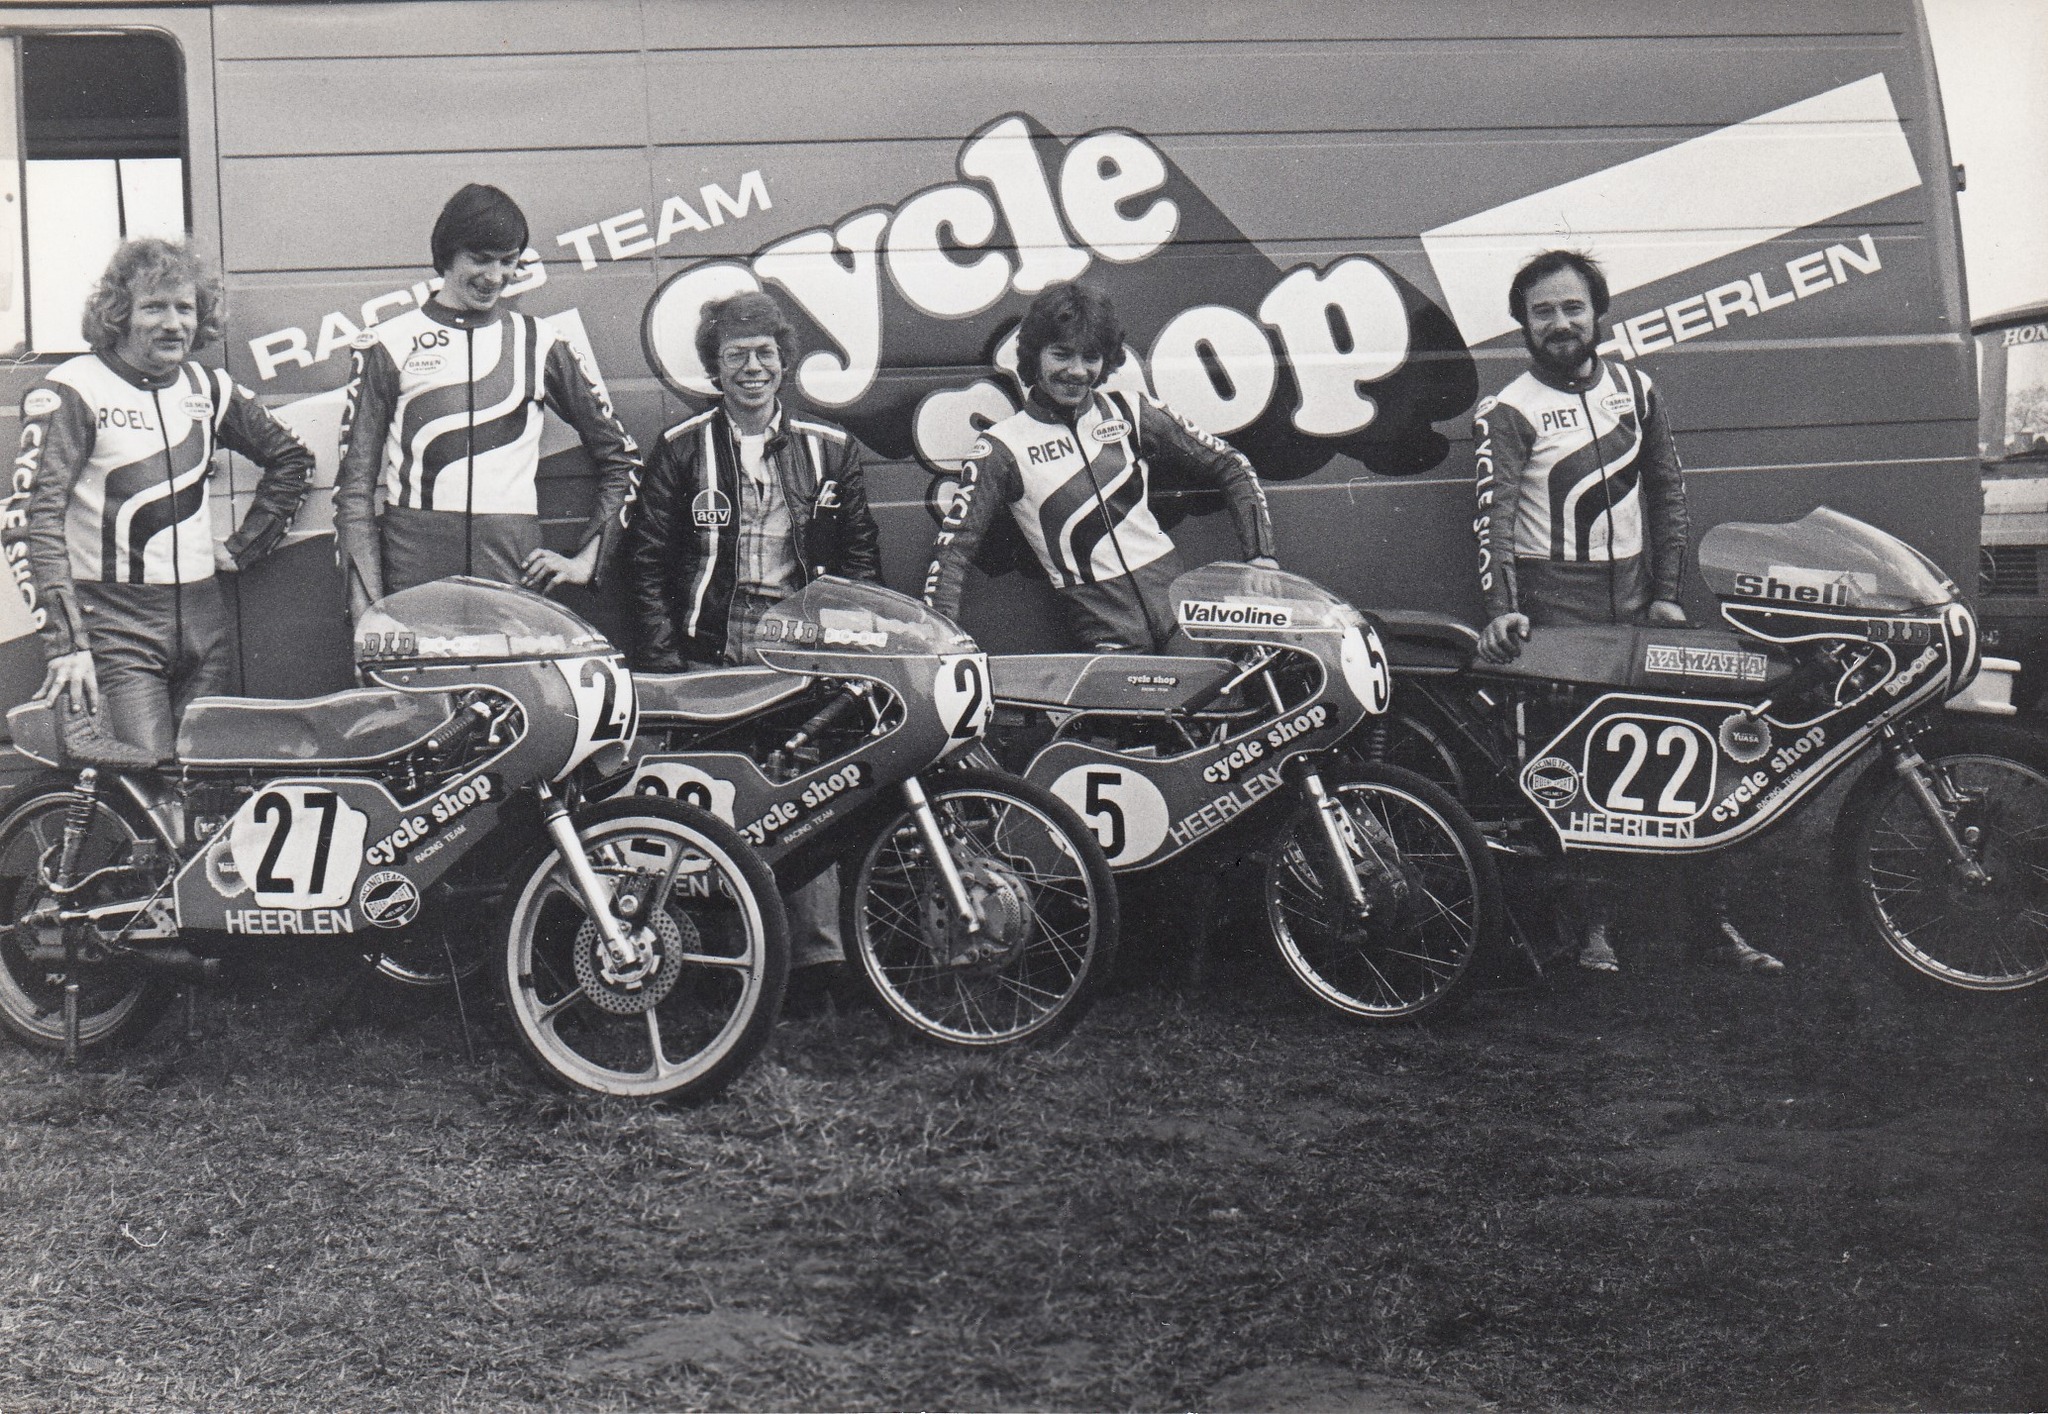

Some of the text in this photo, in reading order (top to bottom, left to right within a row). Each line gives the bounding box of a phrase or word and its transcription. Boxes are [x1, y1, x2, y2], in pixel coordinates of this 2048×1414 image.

[249, 169, 773, 380] RACG TEAM
[646, 115, 1178, 404] cycle
[1595, 233, 1882, 361] HEERLEN
[412, 329, 450, 351] JOS
[98, 407, 154, 430] ROEL
[1541, 408, 1579, 431] PIET
[3, 423, 42, 529] CYCLE
[1027, 436, 1074, 465] RIEN
[1475, 418, 1494, 509] CYCLE
[697, 511, 728, 524] agv
[1473, 516, 1493, 591] SHOP
[5, 541, 48, 630] SHOP
[1184, 603, 1287, 625] Valvoline
[1735, 575, 1847, 605] Shell
[1153, 675, 1176, 685] shop
[1648, 648, 1765, 677] YAMAHA
[1203, 705, 1326, 783] cycle shop
[1606, 722, 1699, 814] 22
[802, 764, 860, 808] shop
[1712, 727, 1825, 822] cycle shop
[366, 774, 491, 865] cycle shop
[783, 809, 835, 844] RACING TEAM
[1086, 772, 1125, 859] 5
[1169, 767, 1284, 847] HEERLEN
[1570, 812, 1695, 839] HEERLEN
[254, 792, 338, 894] 27
[414, 824, 467, 864] RACING TEAM
[225, 908, 354, 934] HEERLEN
